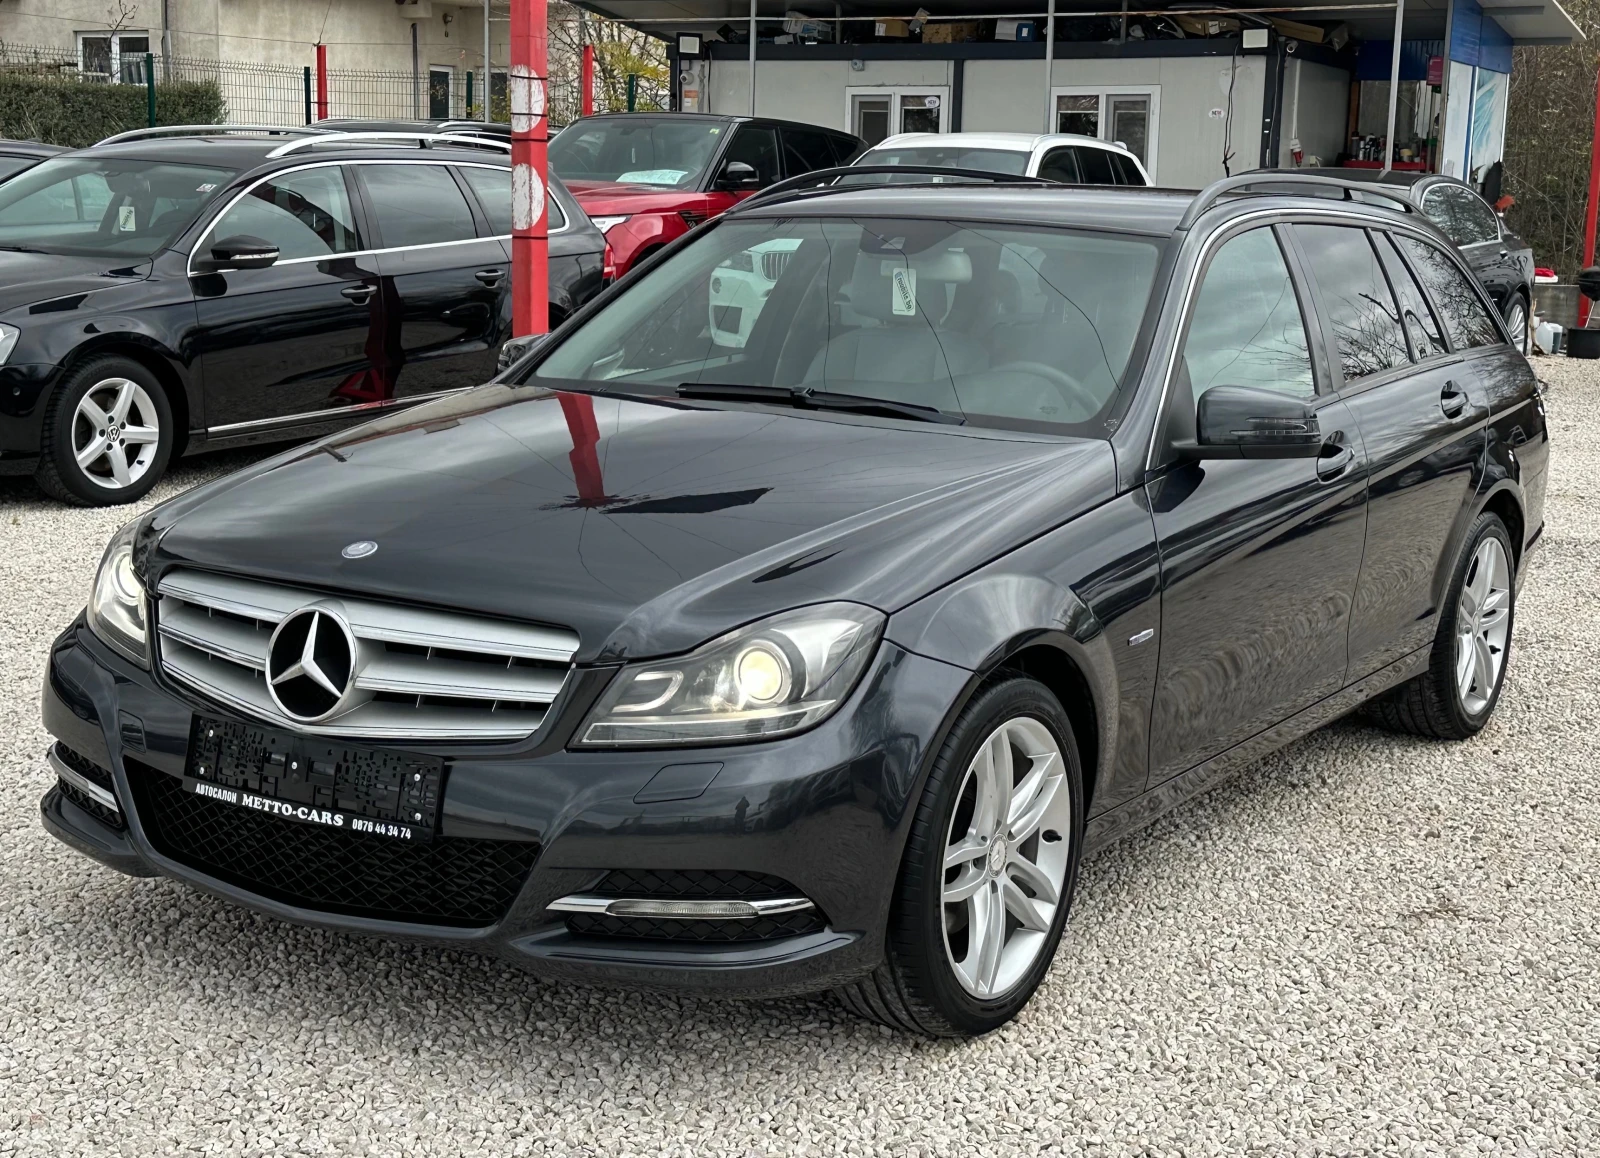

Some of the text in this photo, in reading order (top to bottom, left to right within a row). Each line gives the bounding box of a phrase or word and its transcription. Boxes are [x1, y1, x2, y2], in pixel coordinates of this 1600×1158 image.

[195, 782, 412, 840] АВТОСАЛОН METTO-CARS 0876 44 34 74
